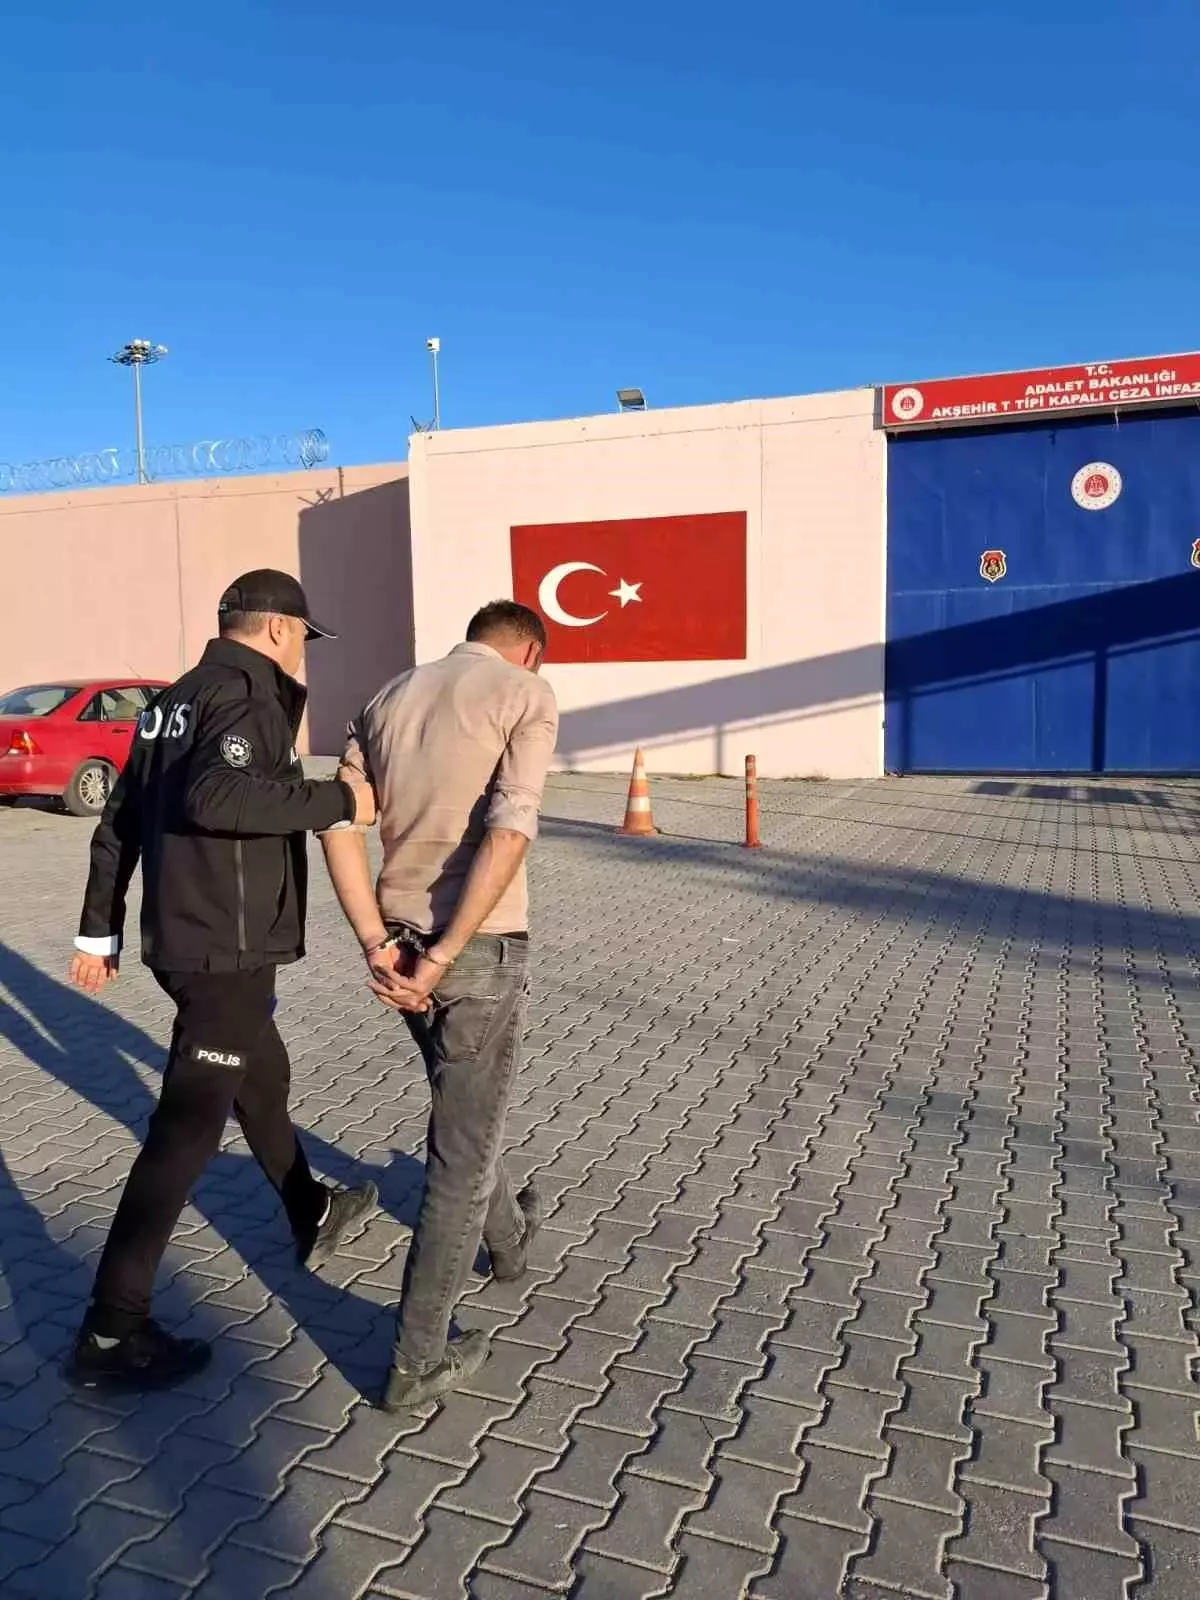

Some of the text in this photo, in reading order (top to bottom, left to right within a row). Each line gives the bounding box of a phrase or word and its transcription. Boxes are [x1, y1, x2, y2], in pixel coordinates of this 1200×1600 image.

[1025, 369, 1176, 396] ADALET BAKANLIĞI
[1085, 365, 1113, 376] T.C.
[932, 381, 1200, 417] AKŞEHİR T TİPİ KAPALI CEZA İNFAZ
